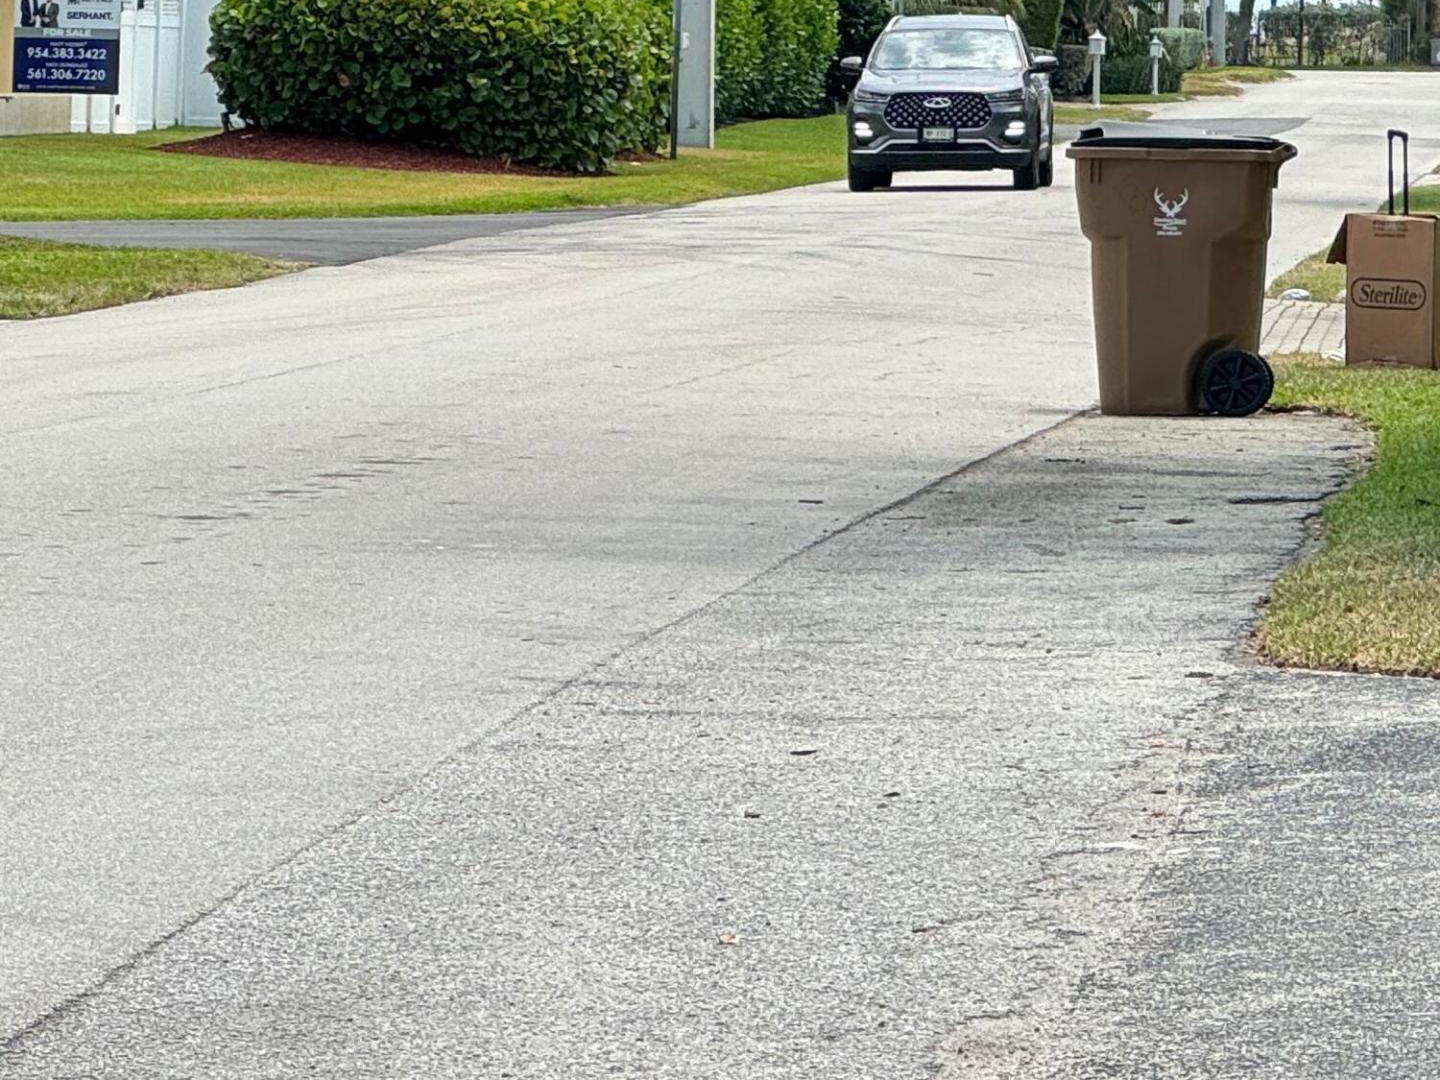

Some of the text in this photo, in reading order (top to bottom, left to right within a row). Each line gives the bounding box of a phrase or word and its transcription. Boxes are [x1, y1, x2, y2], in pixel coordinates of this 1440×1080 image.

[66, 29, 91, 37] SALE
[27, 47, 107, 60] 954.383.3422
[27, 68, 106, 80] 561.306.7220
[1359, 283, 1418, 305] Sterilite
